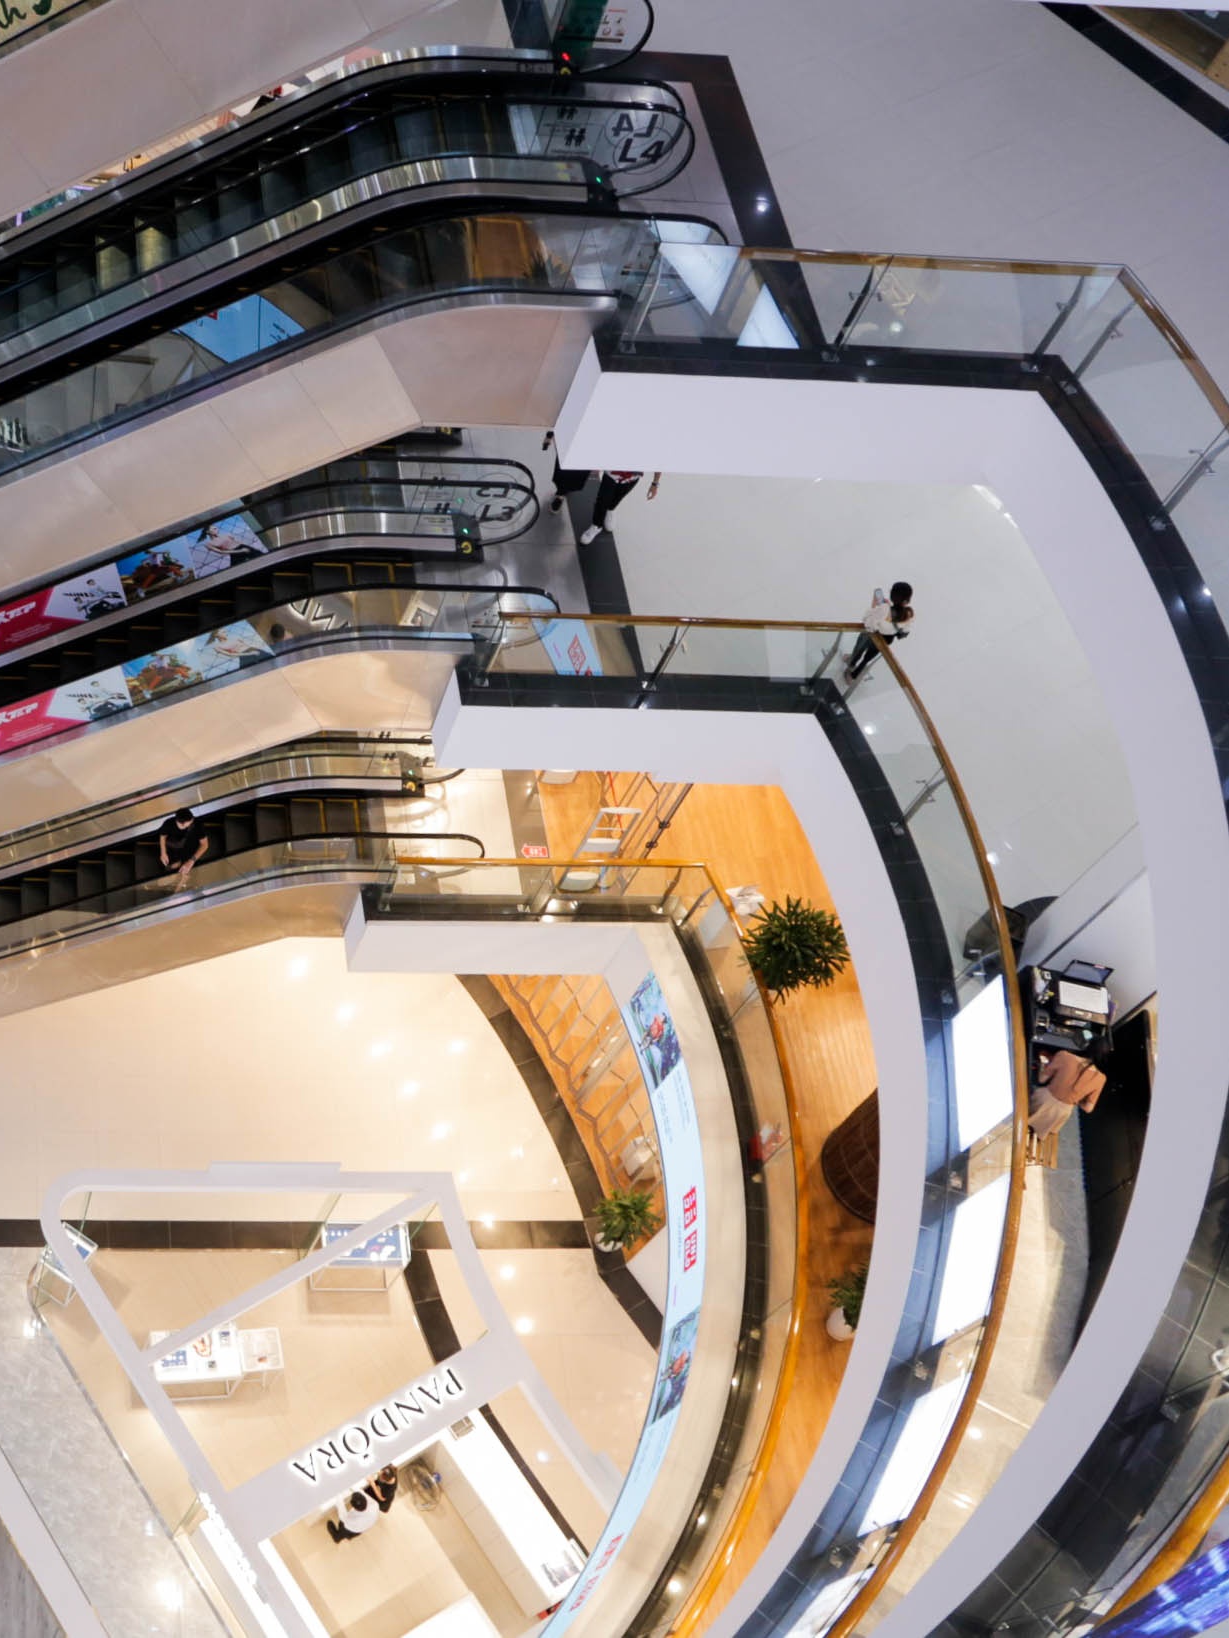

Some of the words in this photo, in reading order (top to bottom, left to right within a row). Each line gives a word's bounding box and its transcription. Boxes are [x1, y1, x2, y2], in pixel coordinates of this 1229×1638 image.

[619, 138, 665, 164] L4
[478, 504, 514, 521] L3
[293, 1368, 463, 1482] PANDORA
